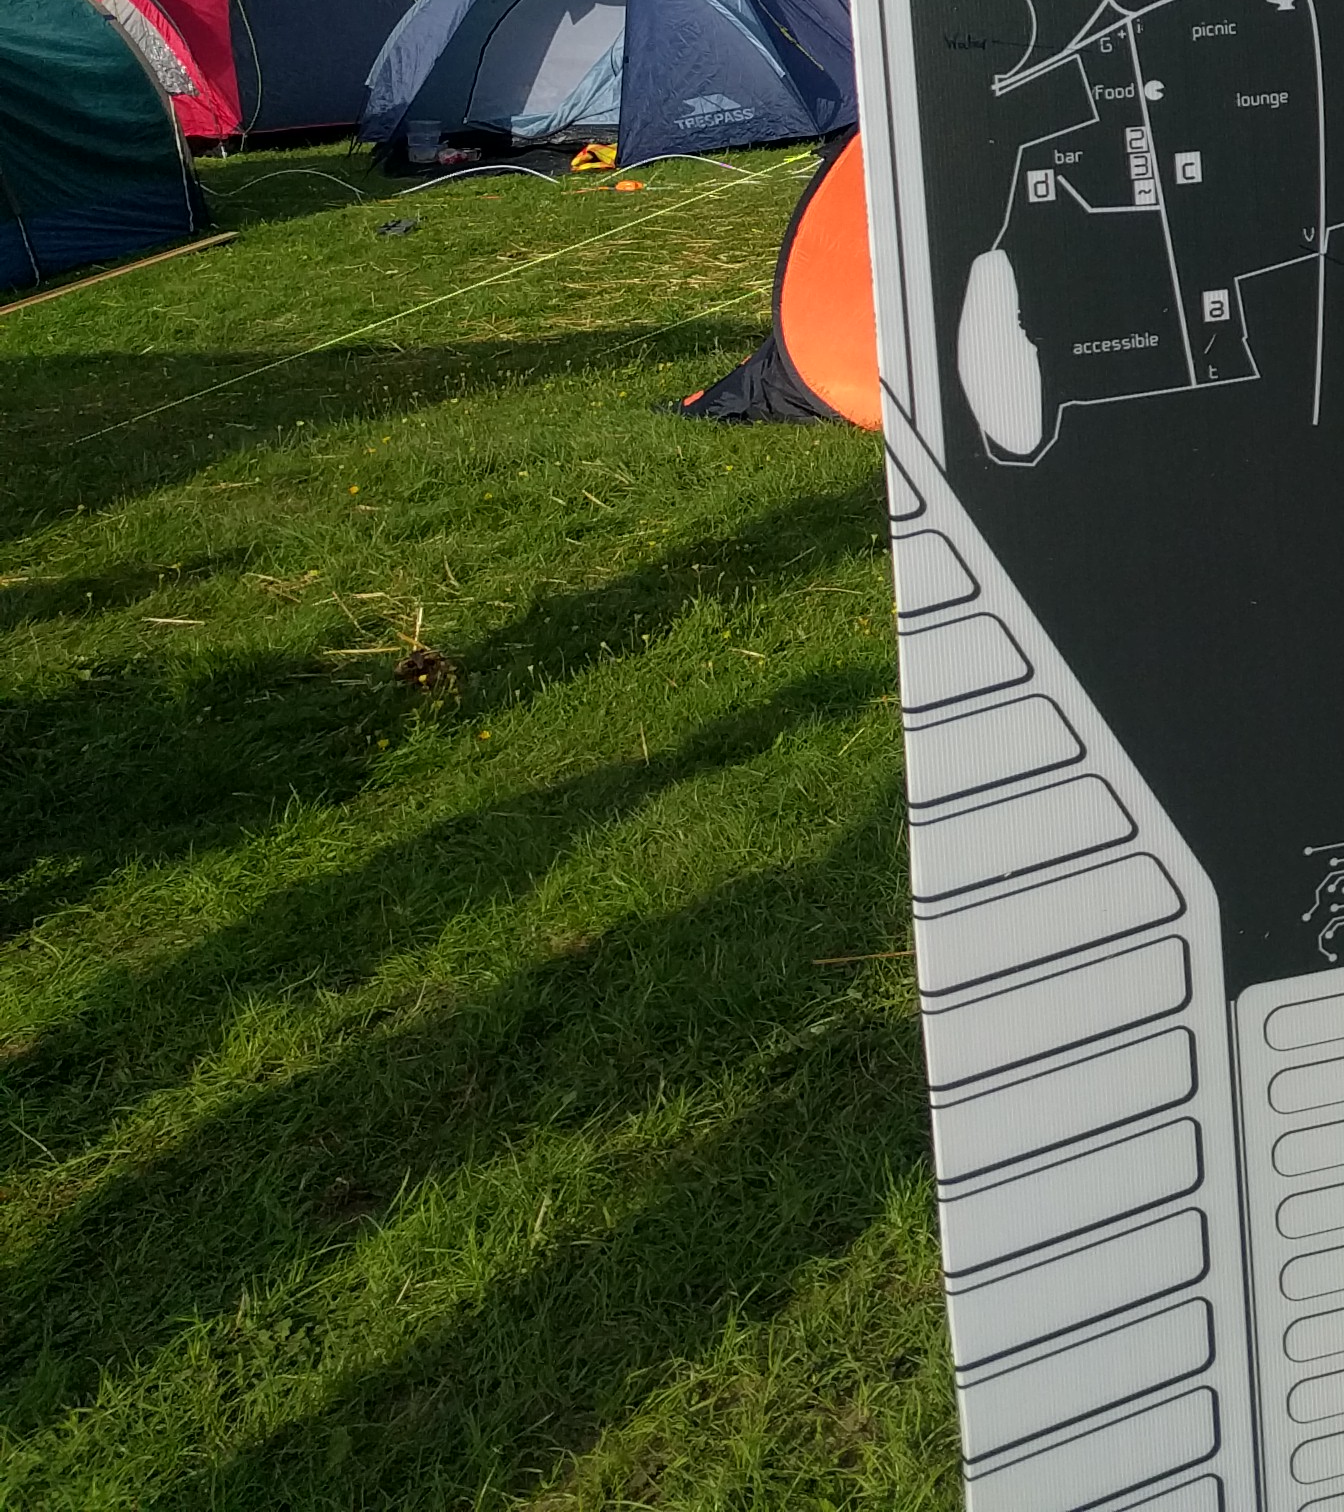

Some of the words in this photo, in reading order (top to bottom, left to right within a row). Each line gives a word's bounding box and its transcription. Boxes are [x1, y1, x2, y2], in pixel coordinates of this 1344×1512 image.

[1192, 19, 1237, 41] picnic
[1236, 92, 1289, 108] lounge
[674, 108, 755, 130] TRESPASS
[1054, 149, 1083, 165] bar
[1073, 332, 1159, 355] accessible
